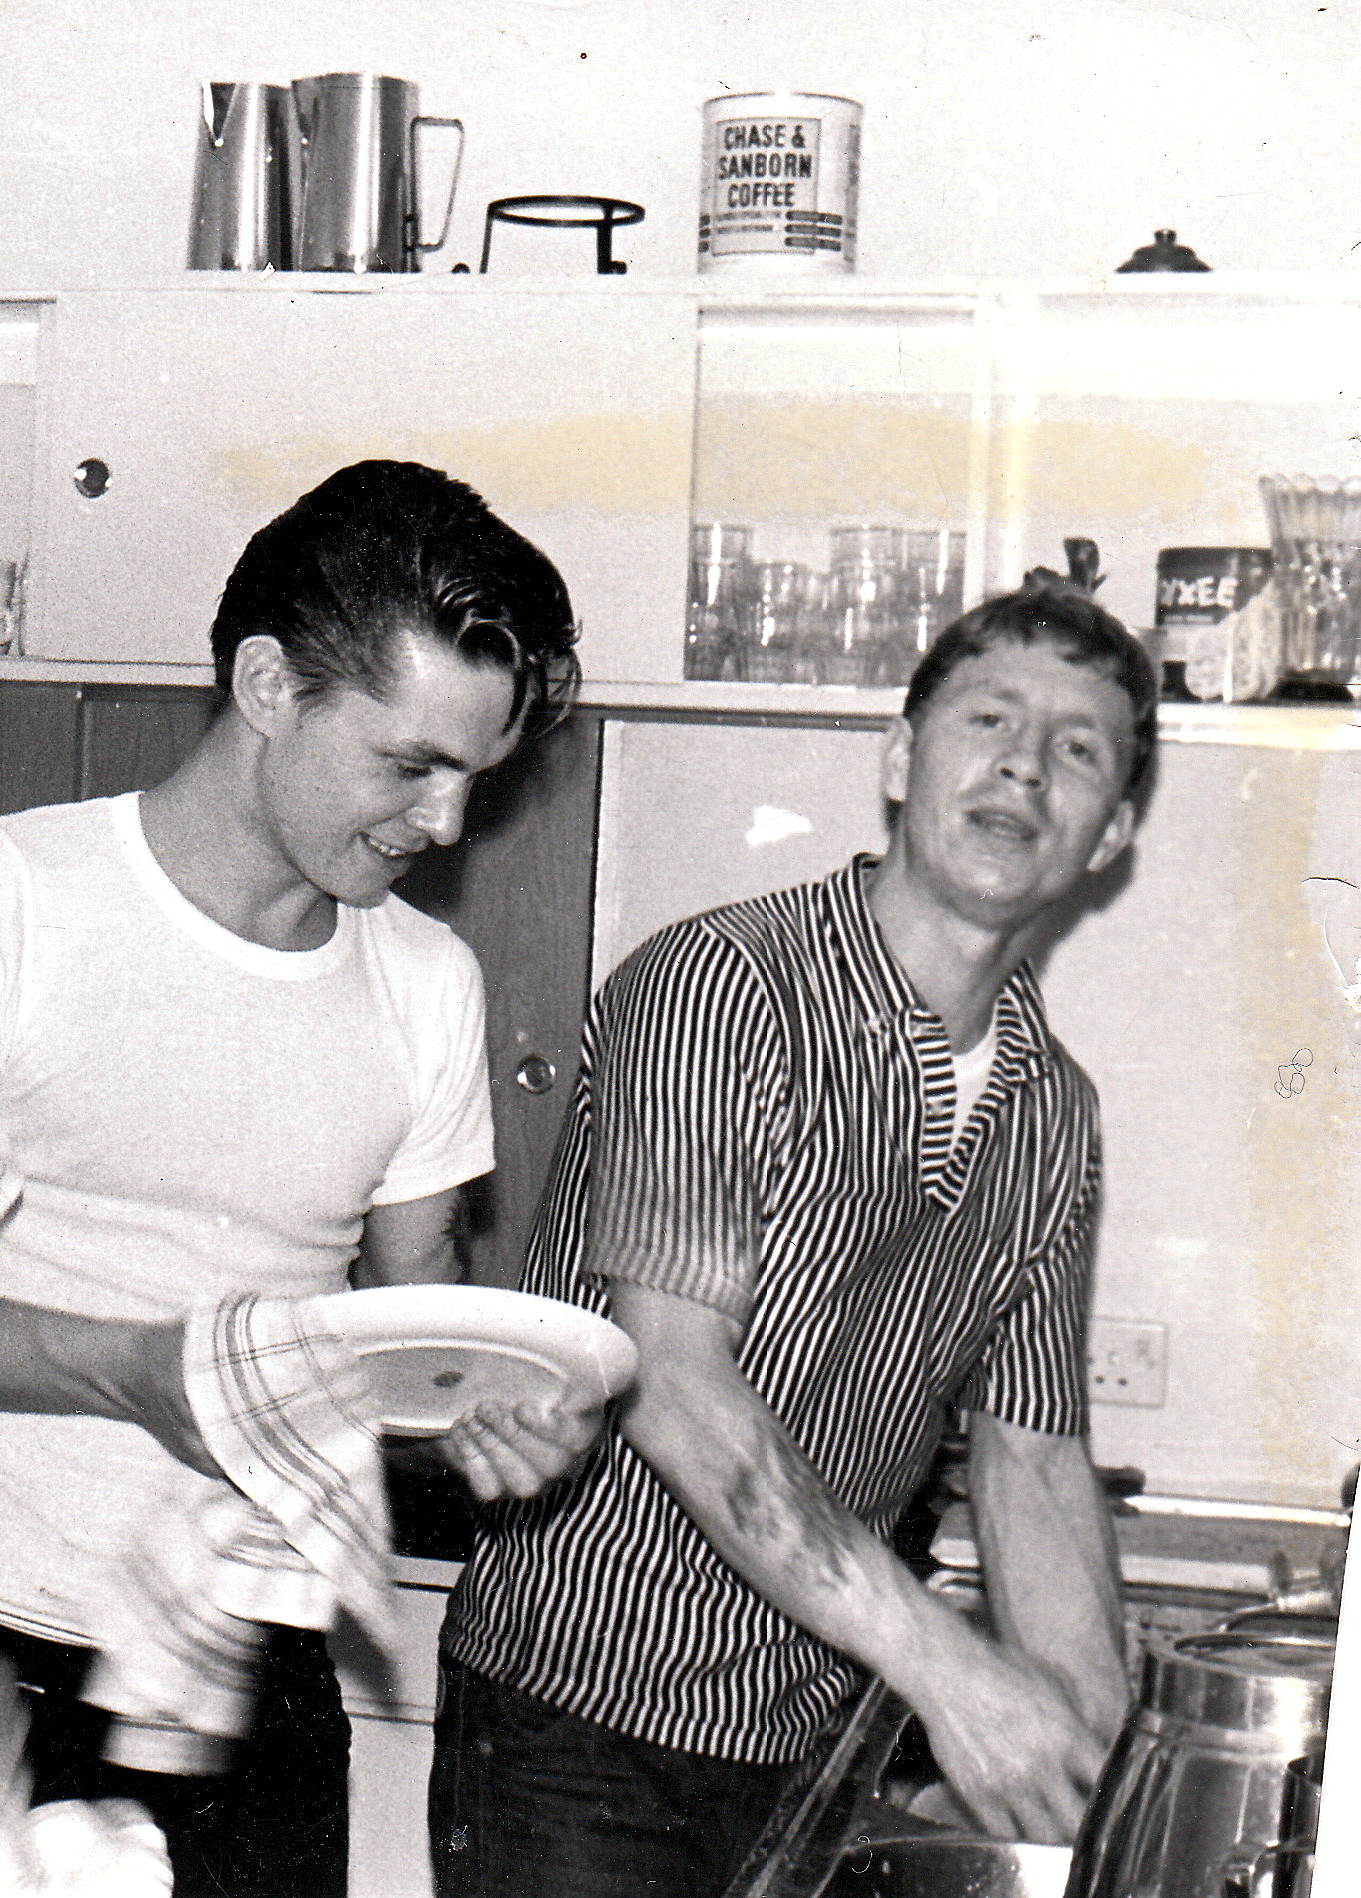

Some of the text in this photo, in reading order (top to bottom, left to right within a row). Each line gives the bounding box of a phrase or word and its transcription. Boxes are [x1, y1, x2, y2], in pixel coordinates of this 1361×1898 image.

[724, 124, 806, 150] CHASE &
[718, 153, 812, 180] SANBORN
[727, 182, 796, 208] COFFEE
